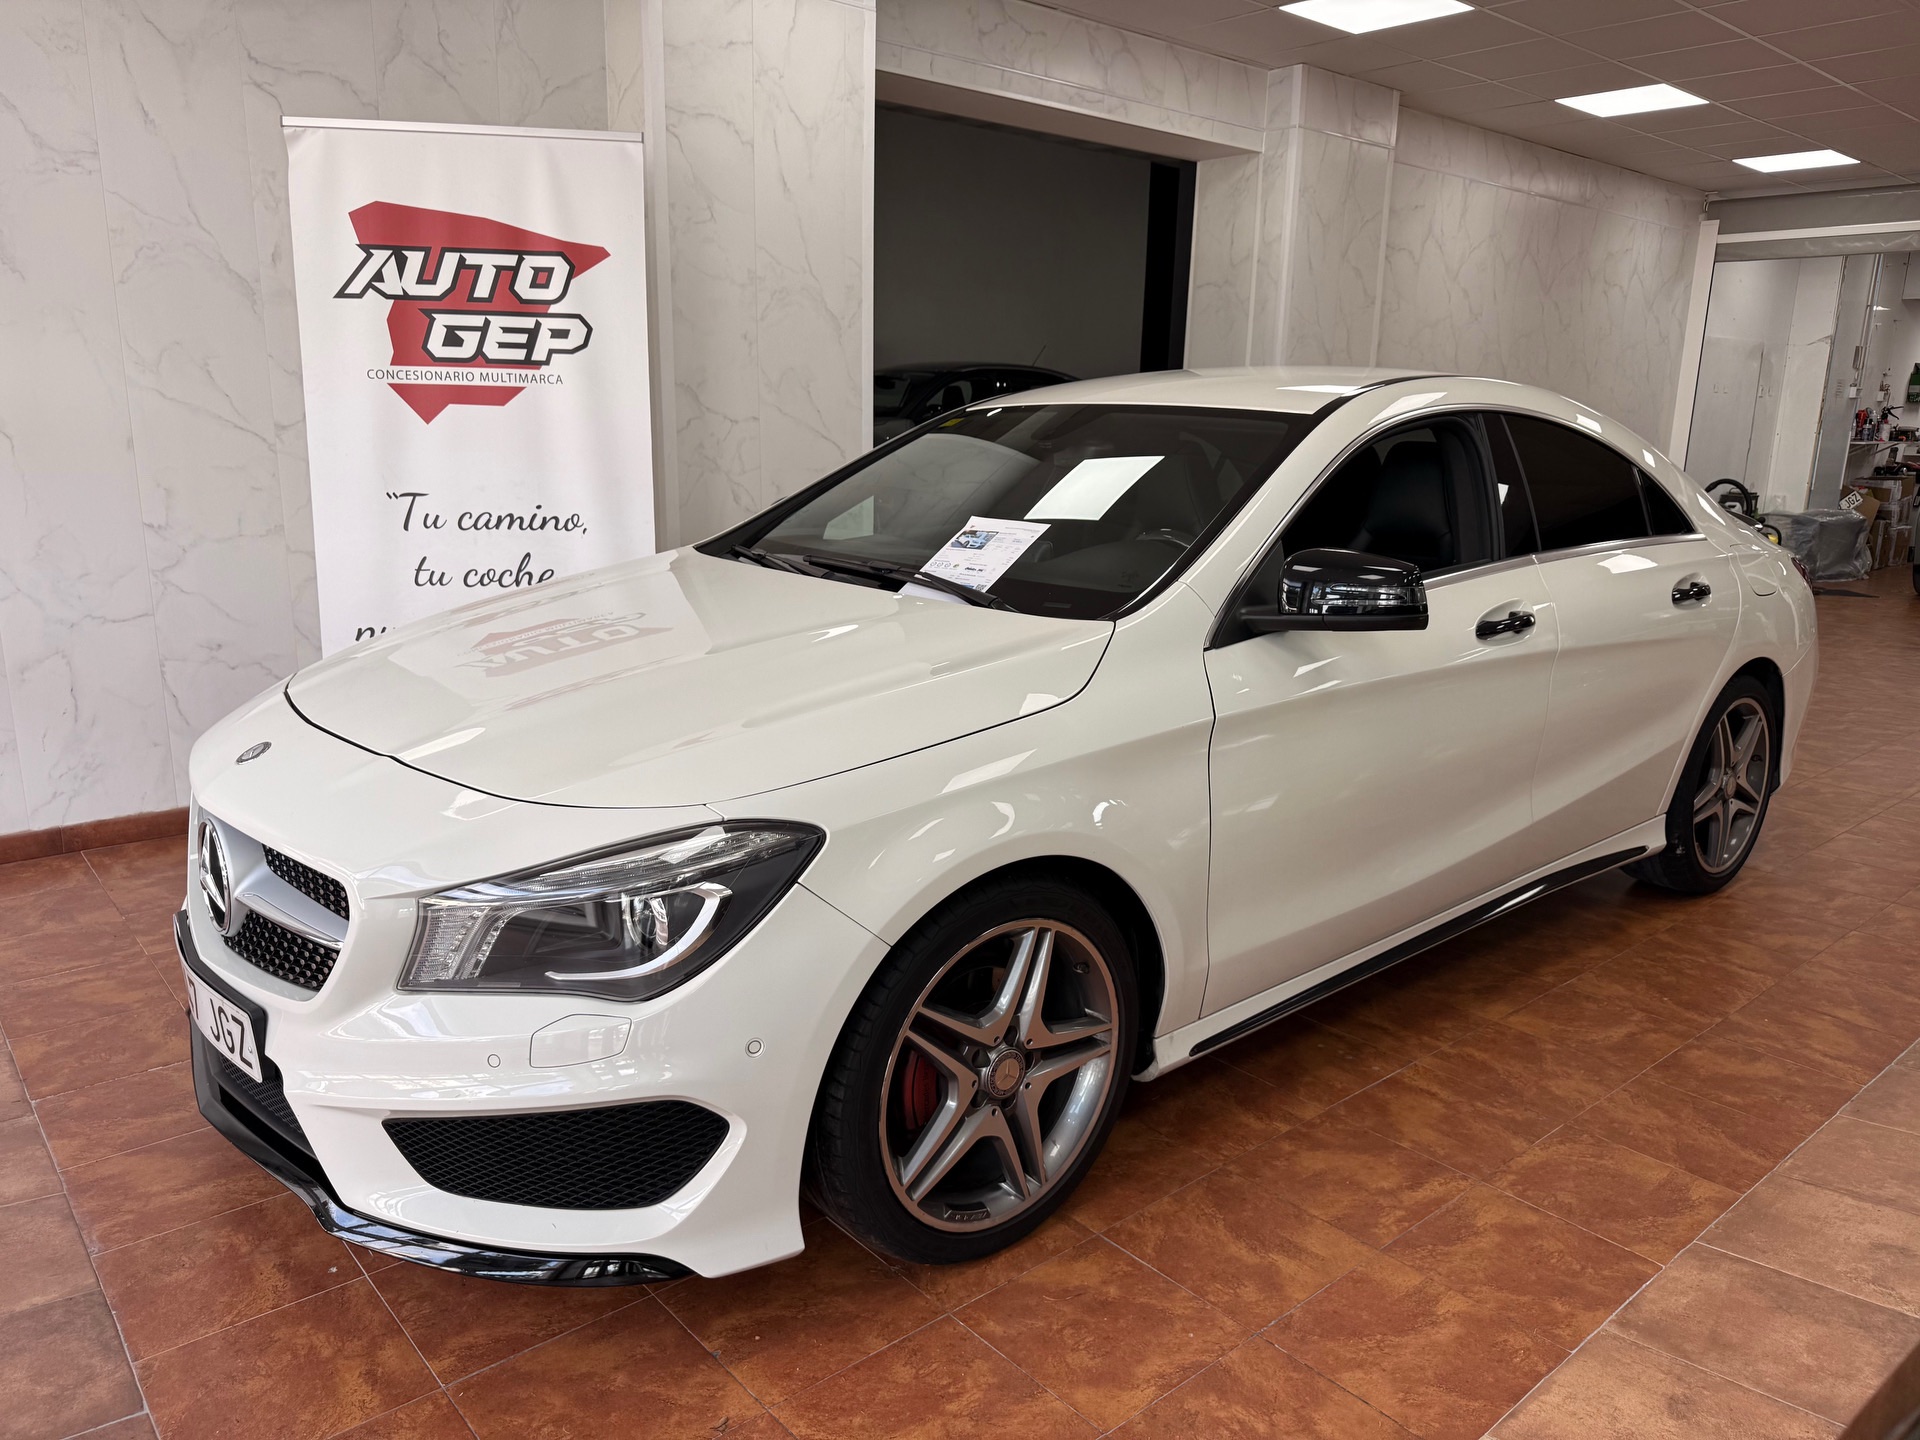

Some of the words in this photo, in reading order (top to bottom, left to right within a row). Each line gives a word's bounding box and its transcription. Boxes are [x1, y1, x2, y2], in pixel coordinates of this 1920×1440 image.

[335, 244, 576, 304] AUTO
[420, 310, 593, 366] GEP
[366, 368, 475, 382] CONCESIONARIO
[479, 371, 564, 385] MULTIMARCA
[457, 504, 588, 536] camino,
[414, 555, 453, 587] tu
[463, 552, 555, 588] coche
[210, 997, 254, 1070] JGZ
